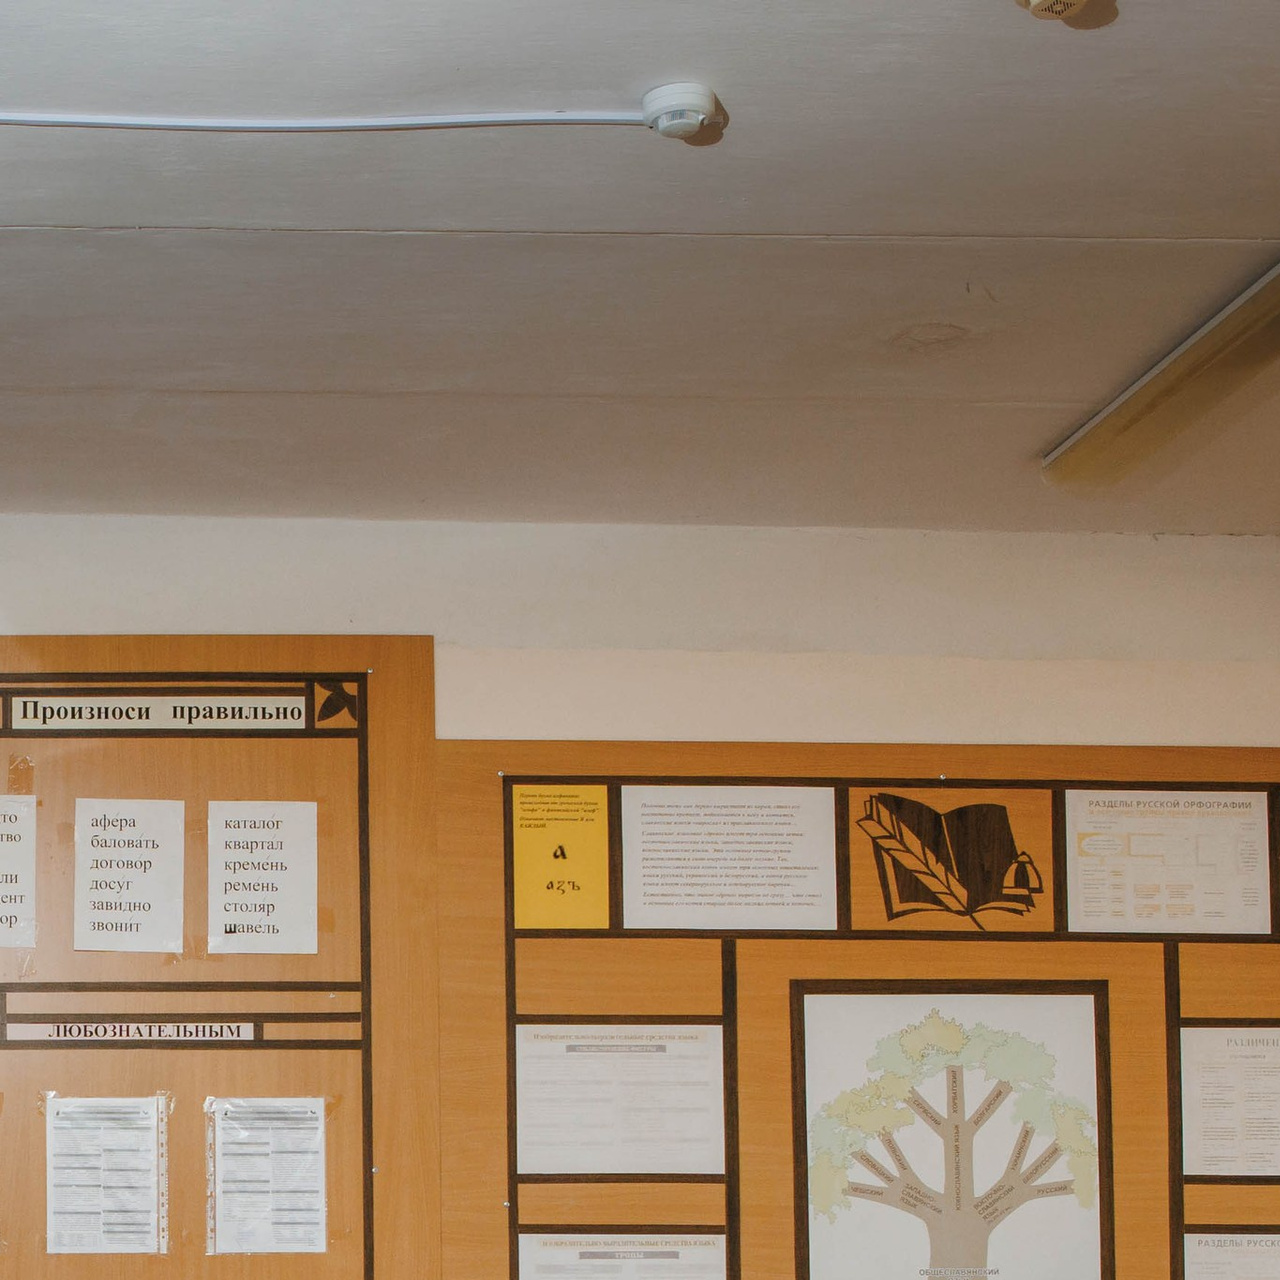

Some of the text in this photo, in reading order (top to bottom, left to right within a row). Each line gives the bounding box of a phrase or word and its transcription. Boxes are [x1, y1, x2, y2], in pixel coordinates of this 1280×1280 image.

[21, 700, 303, 724] Произноси правильно
[1088, 799, 1252, 809] РАЗДЕЛЫ РУССКОЙ ОРФОГРАФИИ
[0, 873, 19, 884] ли
[48, 1024, 241, 1038] ЛЮБОЗНАТЕЛЬНЫМ
[860, 1154, 894, 1183] СЛОВАЦКИЙ
[1022, 1147, 1059, 1184] БЕЛОРУССКИЙ
[1036, 1184, 1068, 1195] РУССКИЙ
[901, 1189, 942, 1214] СЛАВЯНСКИЙ
[978, 1185, 1015, 1215] СЛАВЯНСКИЙ
[1197, 1239, 1243, 1248] РАЗДЕЛЫ
[919, 1268, 1000, 1276] ОБЩЕСЛАВЯНСКИЙ
